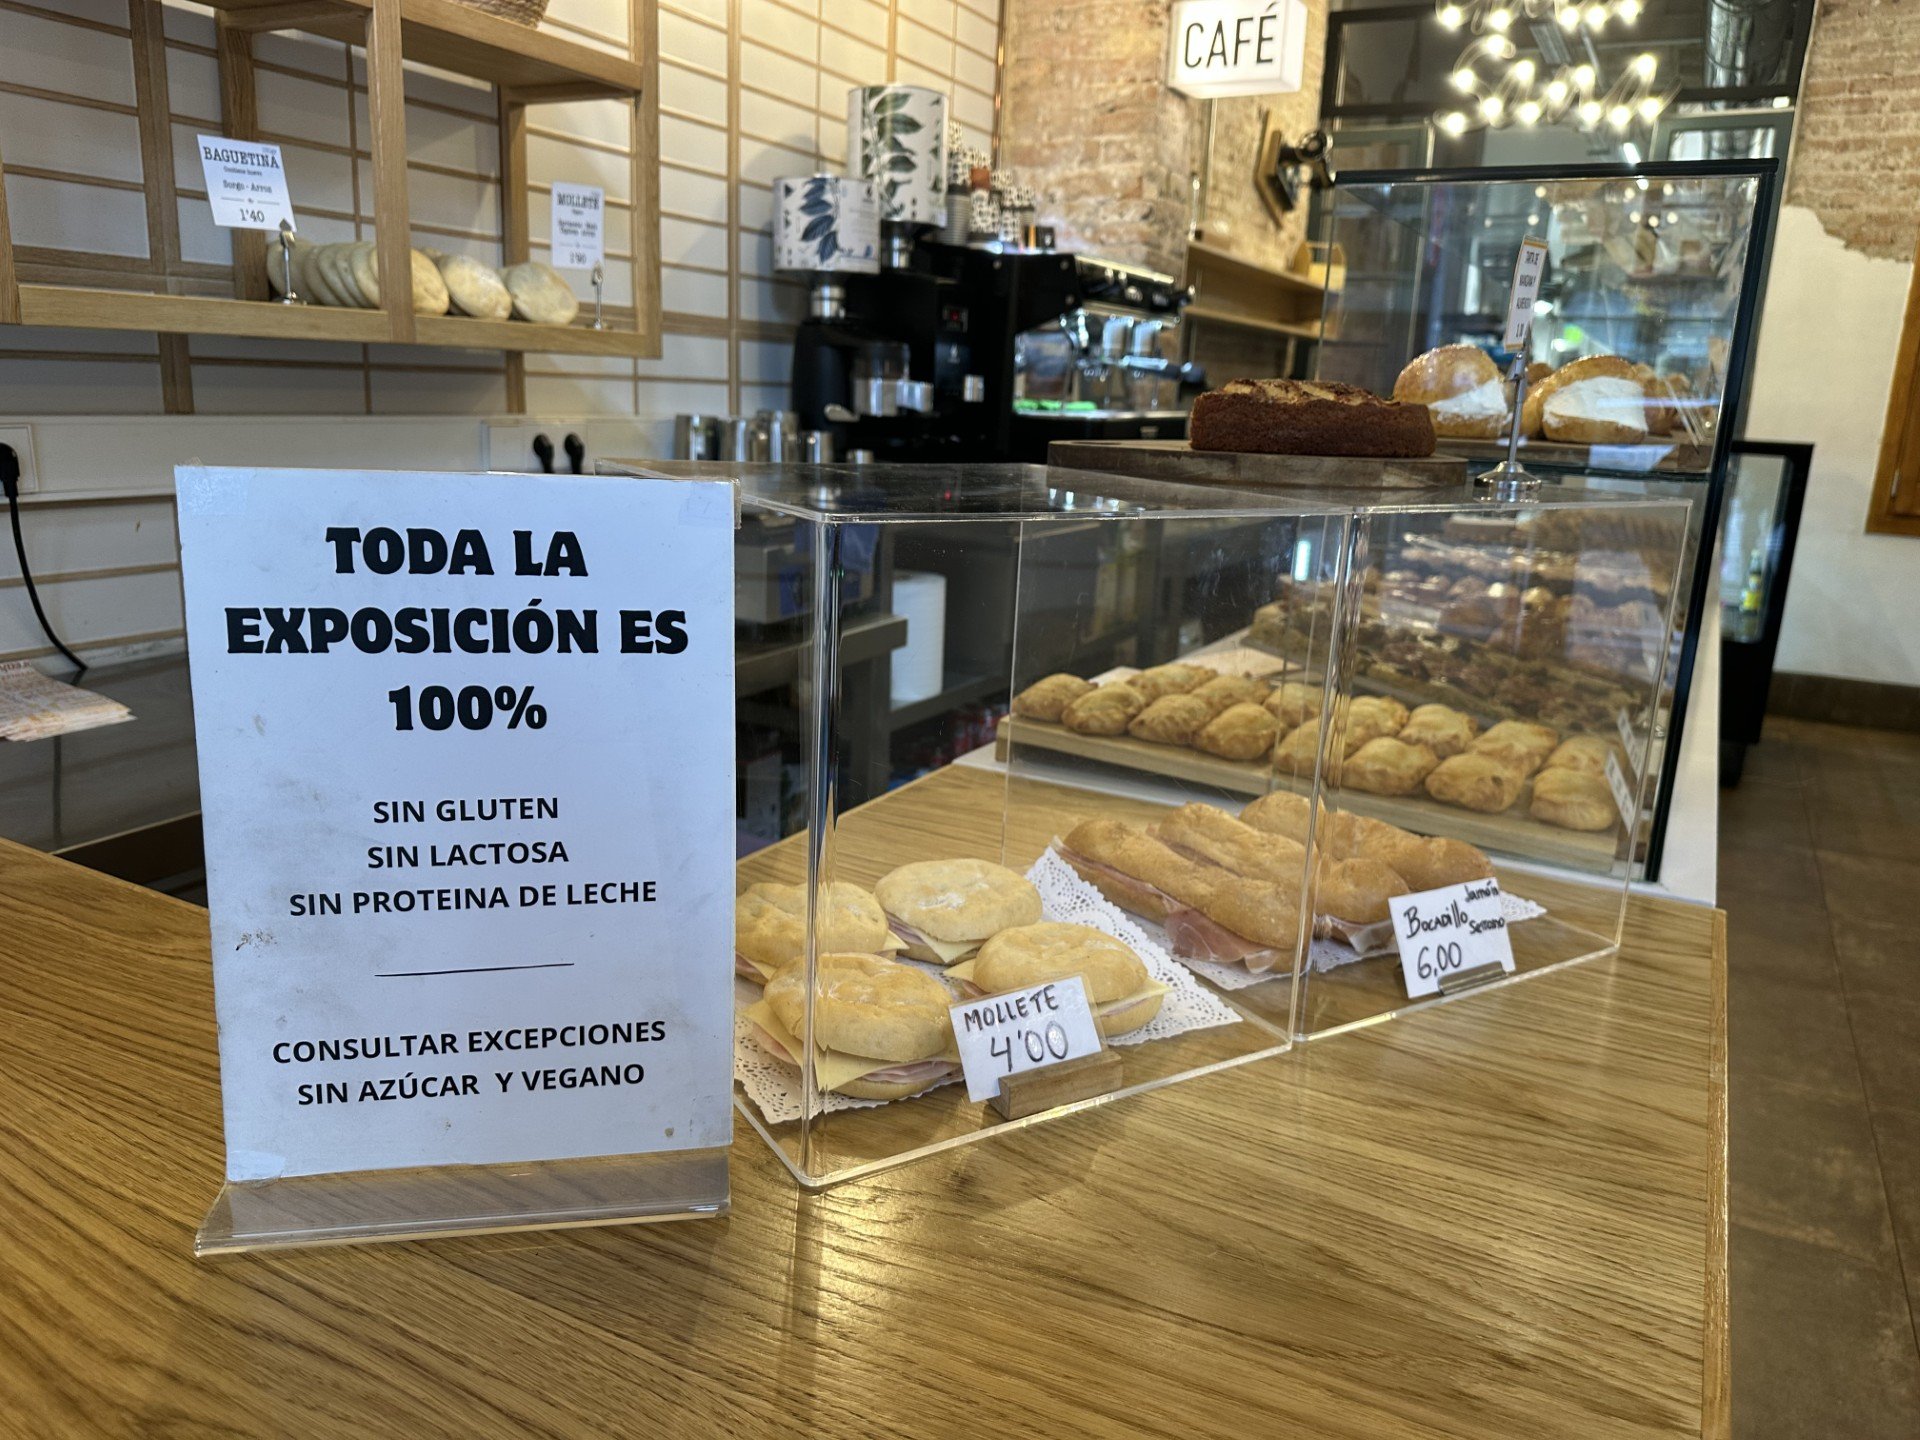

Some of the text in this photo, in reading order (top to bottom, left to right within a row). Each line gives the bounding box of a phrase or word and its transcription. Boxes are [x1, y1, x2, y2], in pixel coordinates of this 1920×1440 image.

[1184, 1, 1278, 69] CAFÉ
[203, 146, 280, 169] BAGUETINA
[325, 527, 589, 578] TODA LA
[225, 599, 689, 655] EXPOSICIÓN ES
[388, 685, 548, 732] 100%
[373, 797, 559, 824] SIN GLUTEN
[367, 841, 570, 869] SIN LACTOSA
[289, 880, 657, 917] SIN PROTEINA DE LECHE
[1464, 880, 1499, 902] Jamón
[963, 984, 1060, 1032] MOLLETE
[272, 1020, 667, 1064] CONSULTAR EXCEPCIONES
[990, 1020, 1069, 1072] 4'00
[298, 1063, 645, 1106] SIN AZÚCAR Y VEGANO
